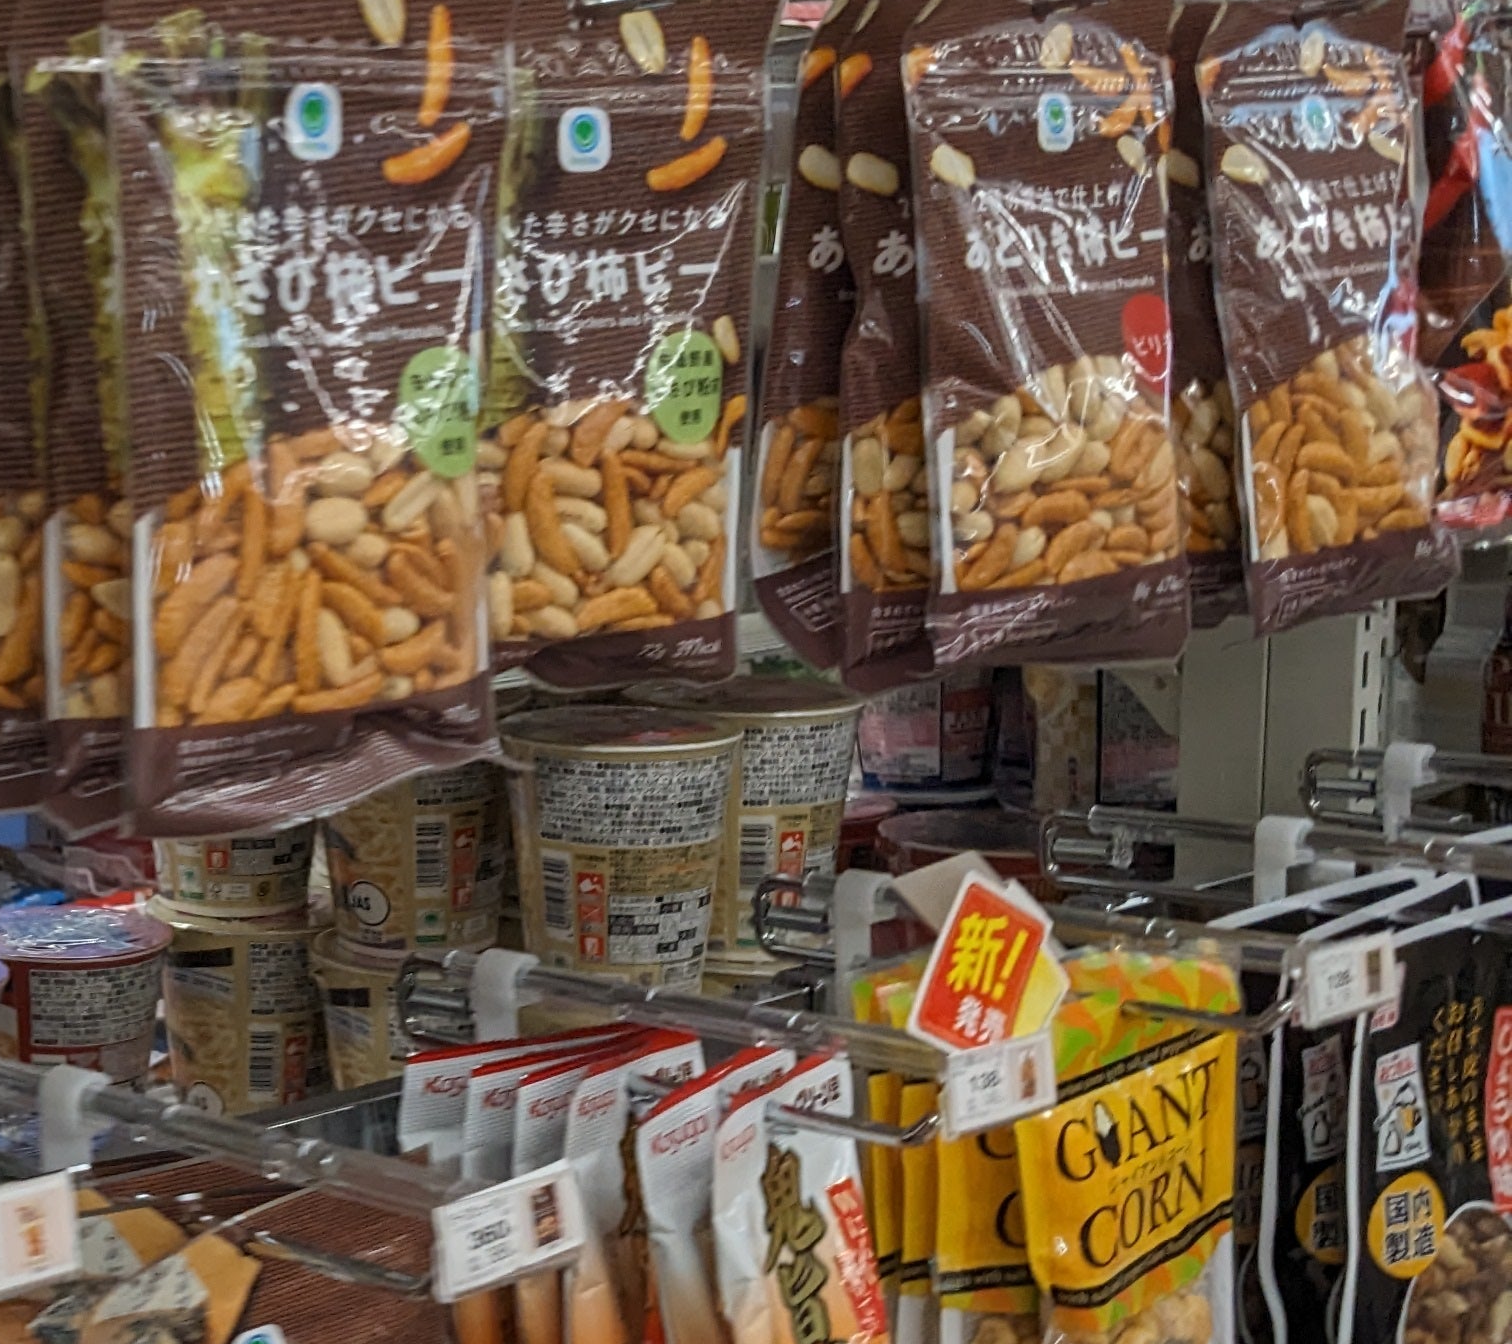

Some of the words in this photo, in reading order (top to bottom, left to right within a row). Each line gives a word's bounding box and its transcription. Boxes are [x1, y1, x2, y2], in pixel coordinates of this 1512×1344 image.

[808, 223, 846, 273] あ
[871, 229, 916, 278] あ
[1077, 1152, 1210, 1270] CORN
